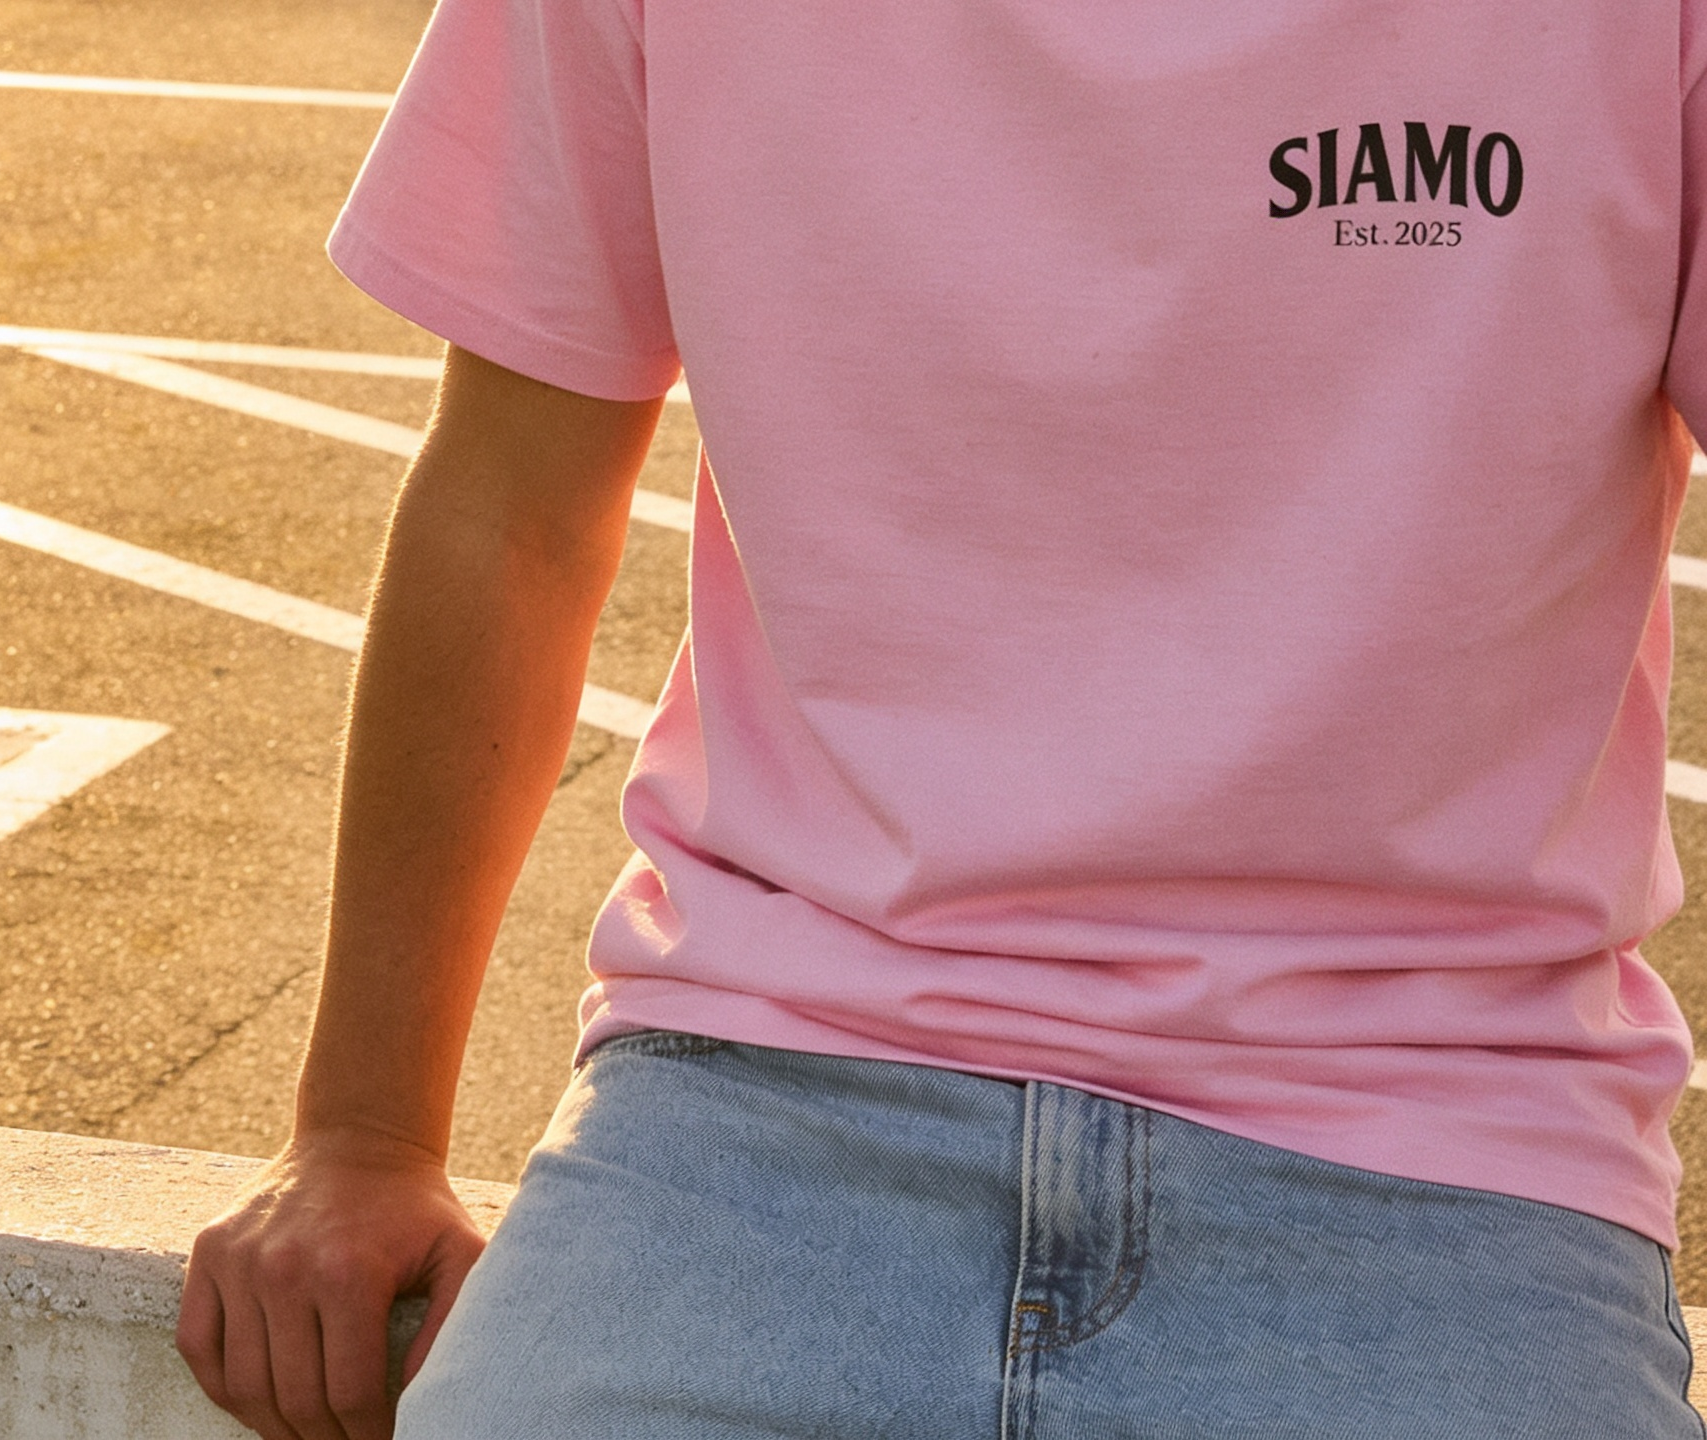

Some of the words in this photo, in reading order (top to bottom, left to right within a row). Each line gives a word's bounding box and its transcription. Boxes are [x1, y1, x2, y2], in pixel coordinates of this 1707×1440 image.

[1268, 121, 1524, 219] SIAMO
[1334, 219, 1388, 247] Est.
[1394, 221, 1463, 247] 2025
